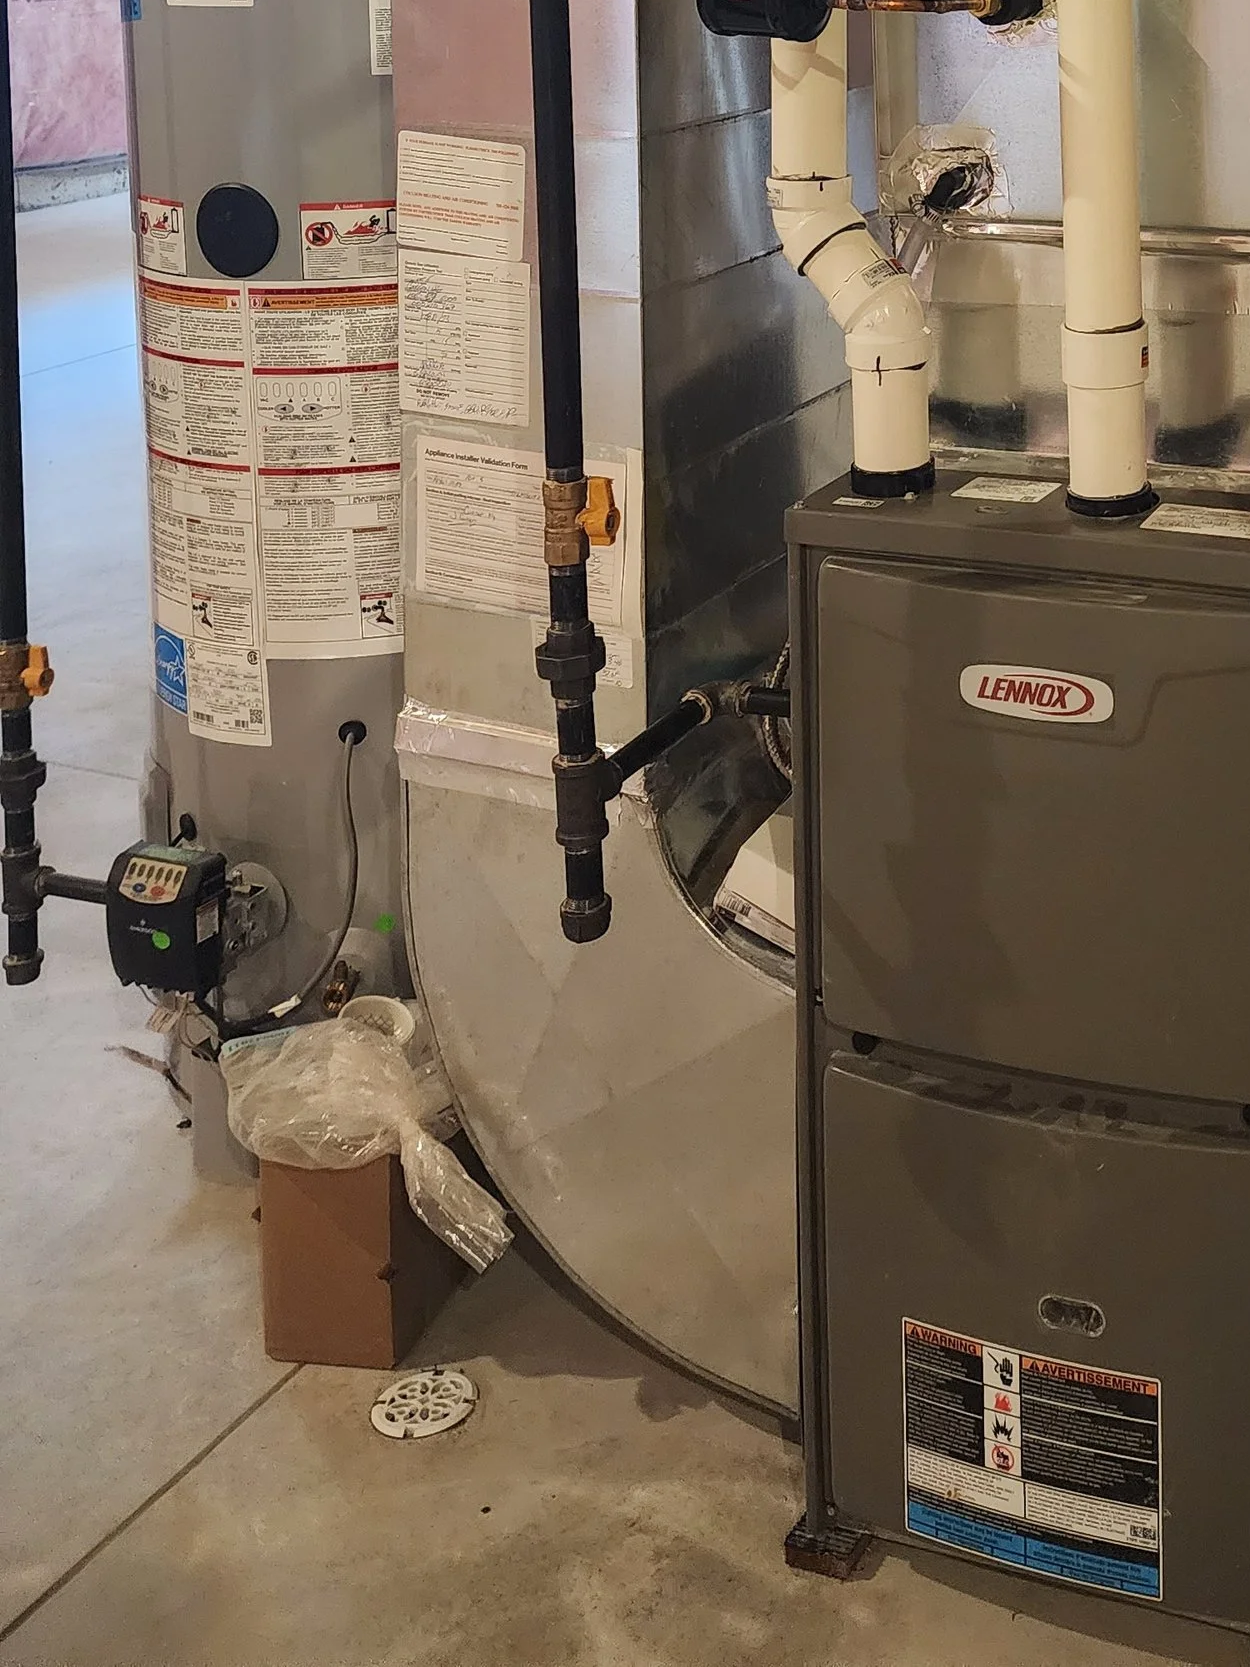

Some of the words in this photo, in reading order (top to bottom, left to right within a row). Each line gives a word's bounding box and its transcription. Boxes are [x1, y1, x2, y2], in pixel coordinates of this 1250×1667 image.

[424, 448, 454, 459] Appliance
[455, 453, 480, 463] Installer
[480, 456, 511, 468] Validation
[511, 461, 529, 470] Form
[976, 676, 1072, 709] LENNOX
[920, 1328, 977, 1355] WARNING
[1041, 1362, 1149, 1393] AVERTISSEMENT
